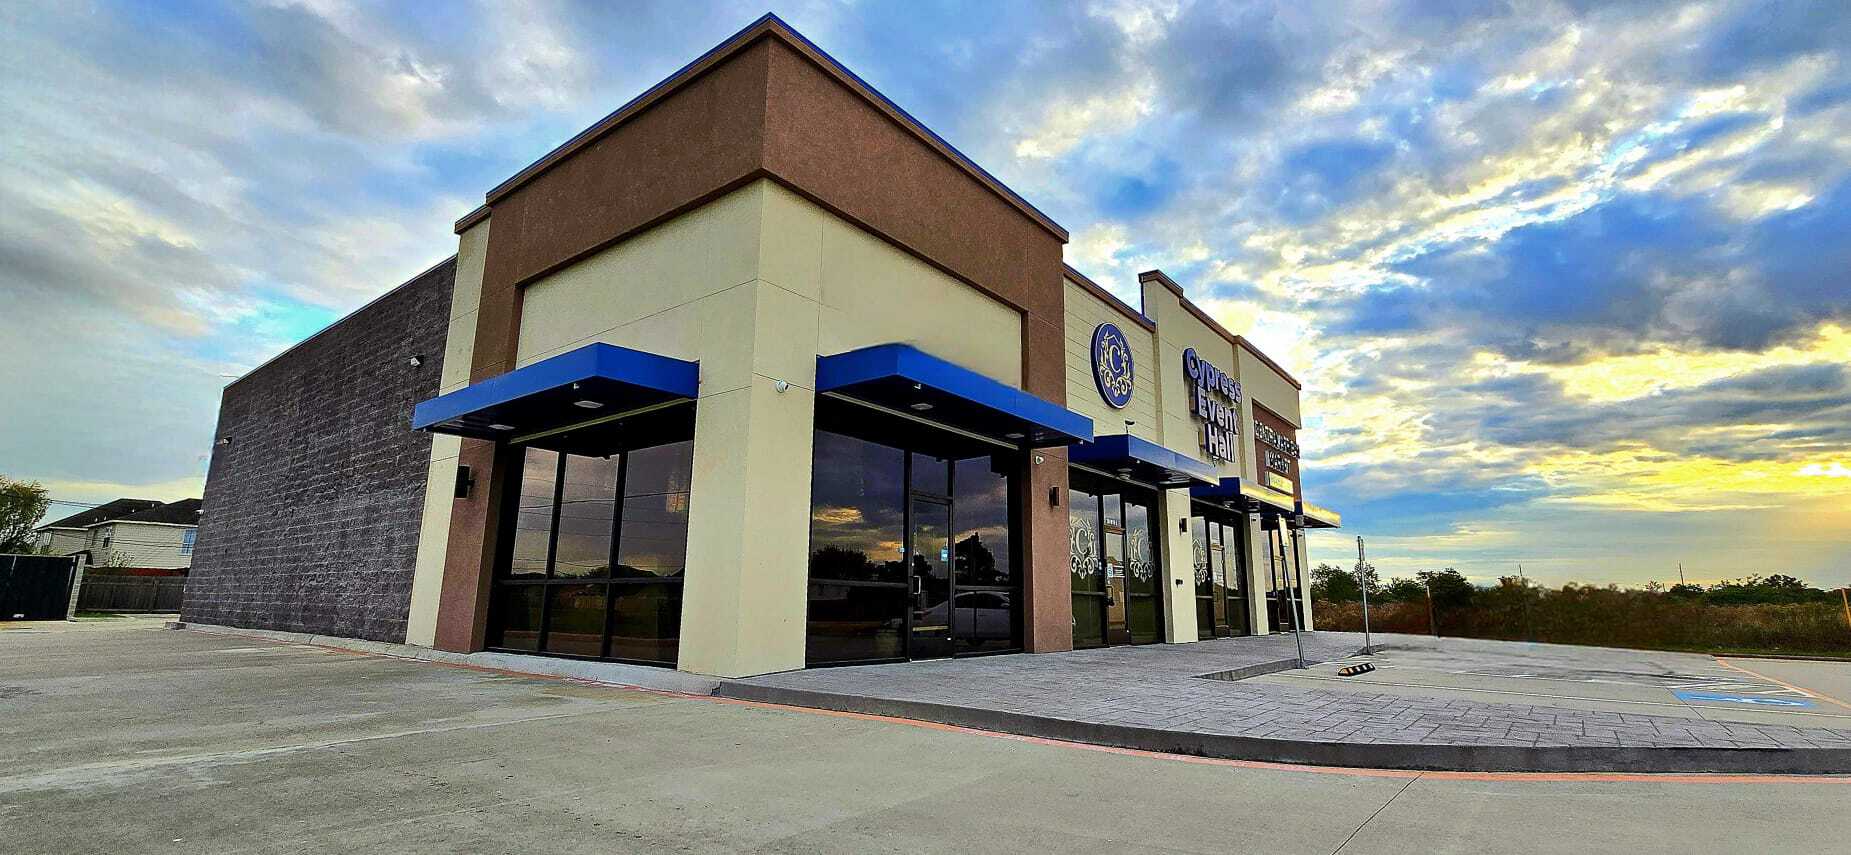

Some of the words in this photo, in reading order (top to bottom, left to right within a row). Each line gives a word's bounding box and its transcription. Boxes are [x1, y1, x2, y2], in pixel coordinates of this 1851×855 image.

[1183, 347, 1242, 403] Cypress
[1195, 386, 1239, 435] Event
[1205, 423, 1236, 463] Hall
